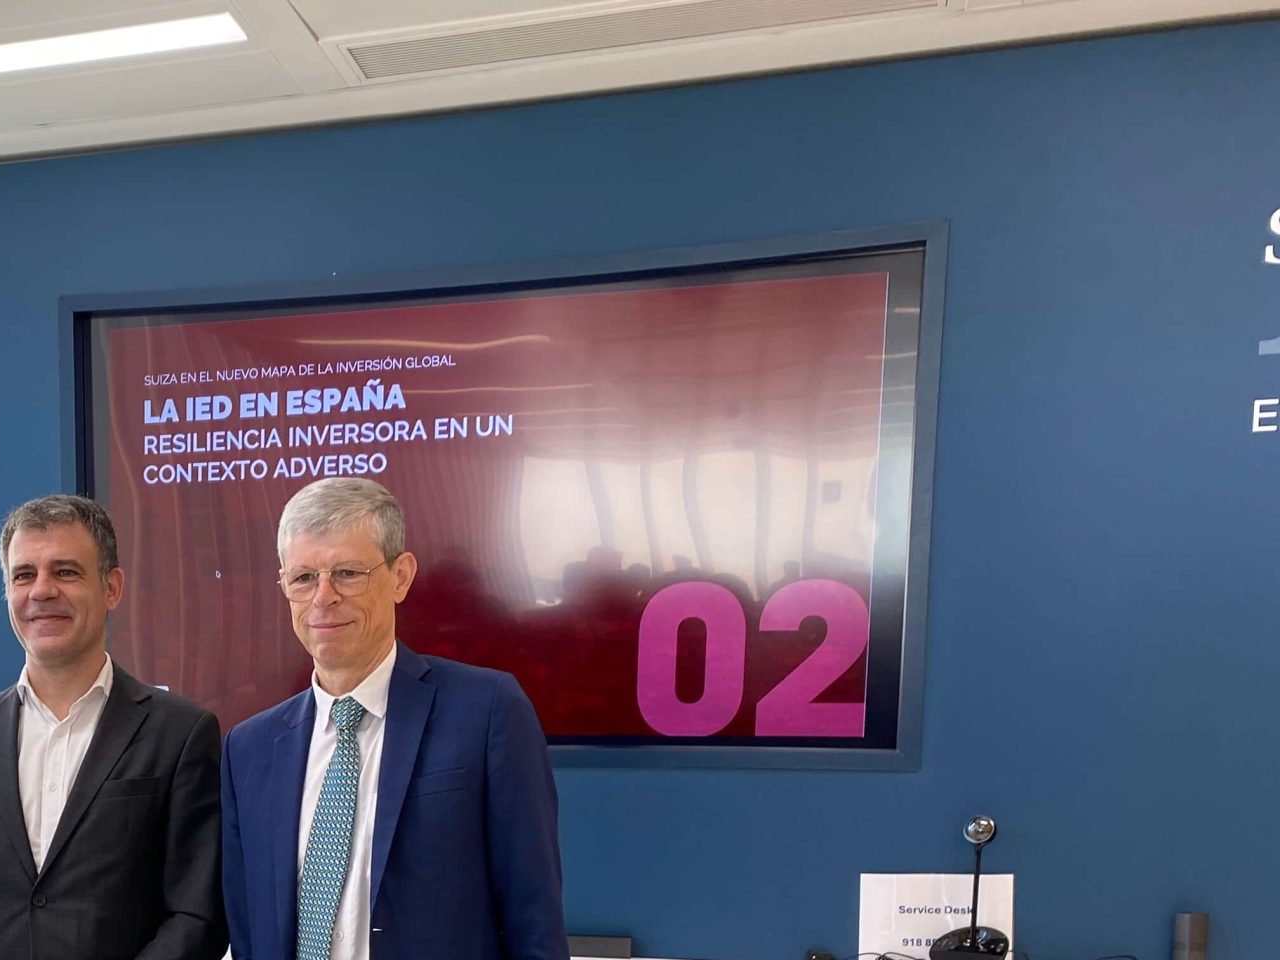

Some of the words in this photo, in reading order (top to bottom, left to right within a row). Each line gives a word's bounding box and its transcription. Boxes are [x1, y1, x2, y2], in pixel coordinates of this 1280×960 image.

[144, 373, 178, 386] SUIZA
[181, 372, 197, 384] EN
[200, 371, 213, 382] EL
[216, 367, 258, 381] NUEVO
[261, 365, 296, 378] MAPA
[299, 363, 314, 375] DE
[318, 361, 333, 374] LA
[336, 356, 402, 373] INVERSIÓN
[405, 355, 456, 369] GLOBAL
[144, 398, 180, 424] LA
[186, 395, 233, 422] IED
[239, 391, 279, 418] EN
[286, 378, 406, 415] ESPAÑA
[144, 427, 282, 455] RESILIENCIA
[288, 419, 428, 448] INVERSORA
[434, 416, 468, 439] EN
[475, 414, 514, 436] UN
[143, 459, 268, 484] CONTEXTO
[273, 453, 388, 479] ADVERSO
[637, 578, 869, 738] 02
[898, 905, 941, 914] Service
[902, 938, 922, 947] 918
